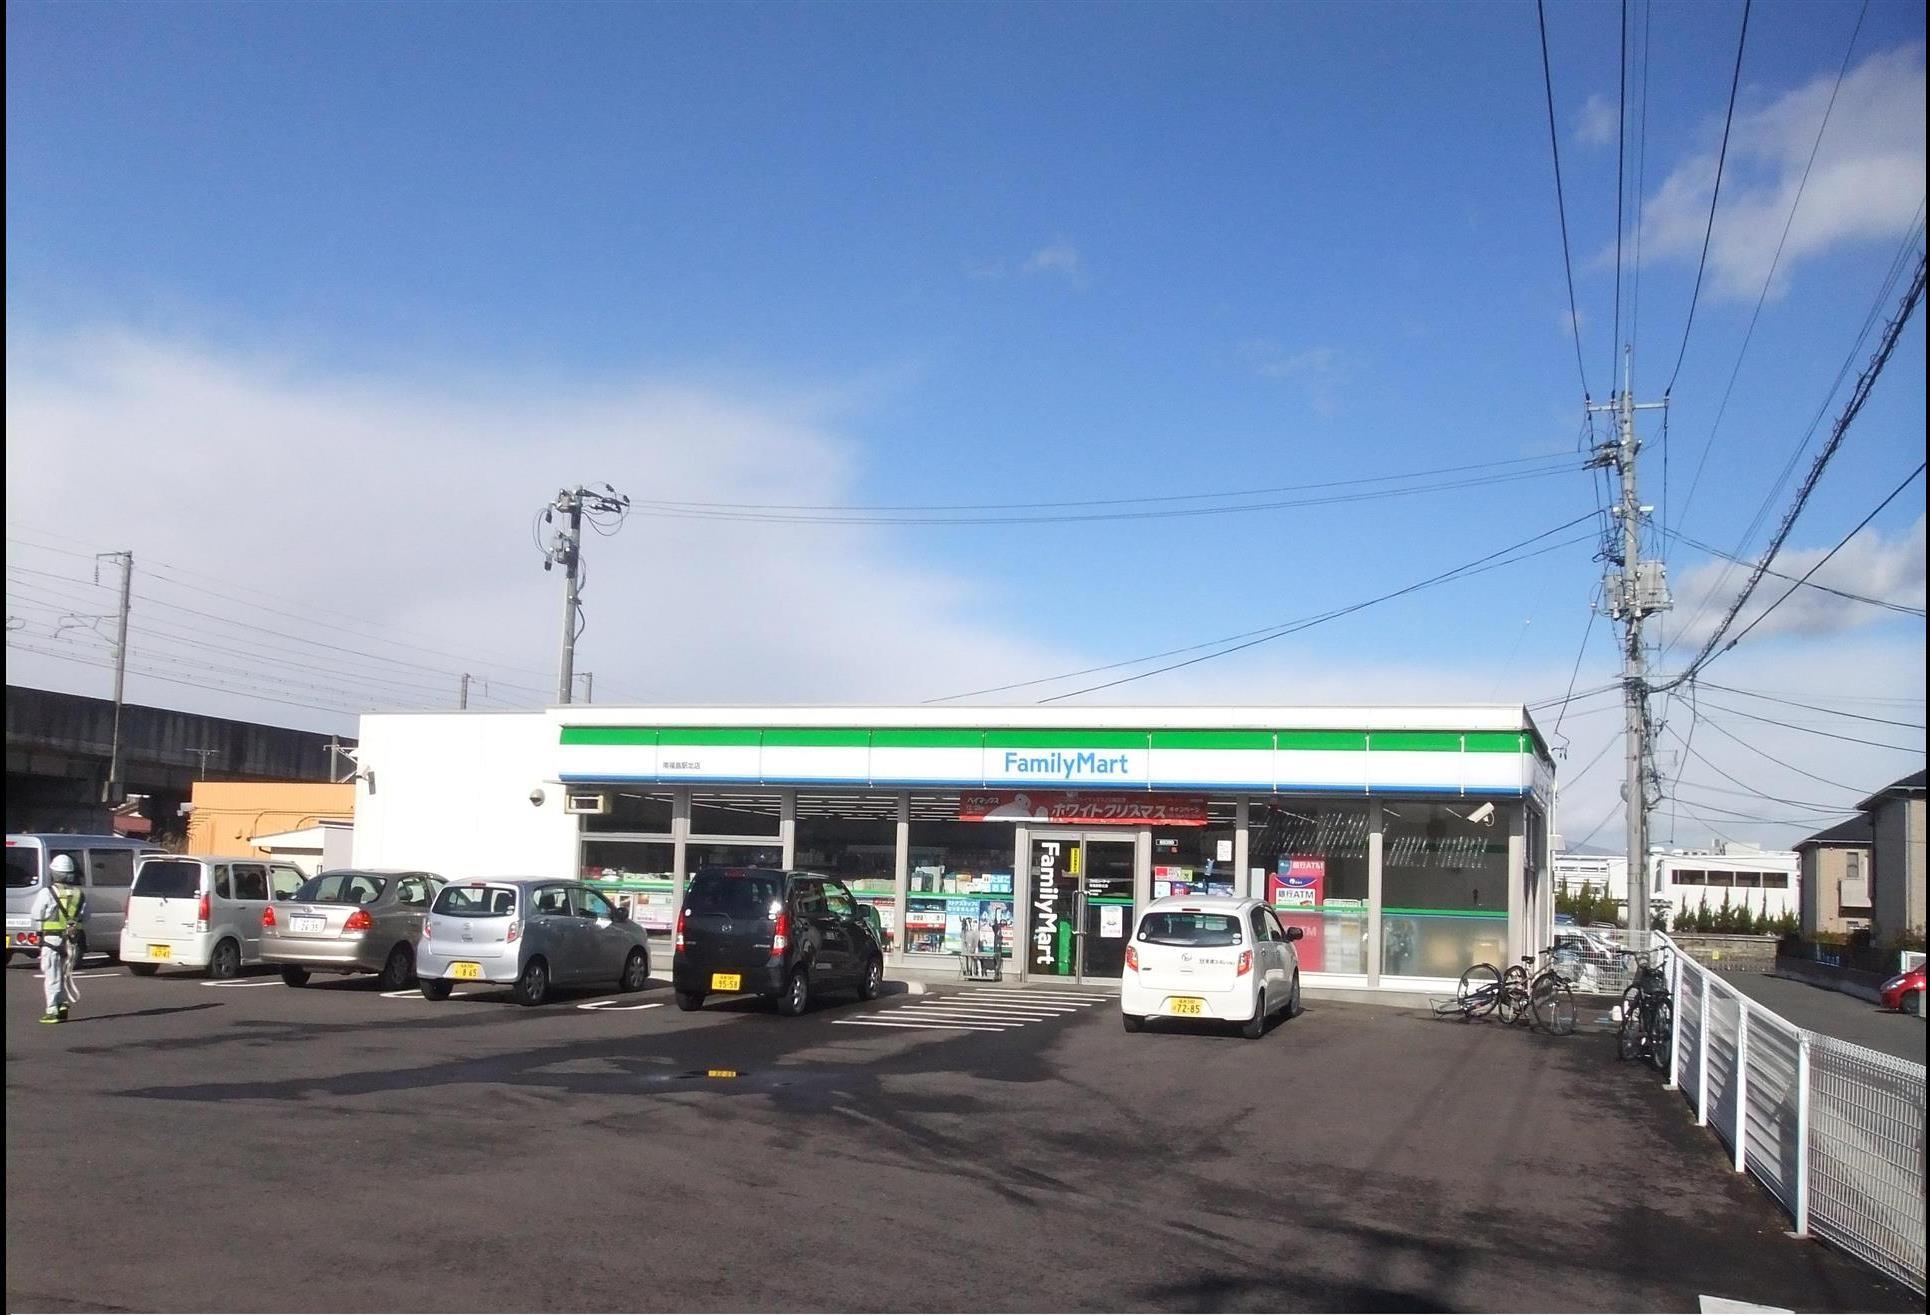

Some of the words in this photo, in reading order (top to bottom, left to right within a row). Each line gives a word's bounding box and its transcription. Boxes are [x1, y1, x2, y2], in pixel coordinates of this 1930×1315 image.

[1005, 752, 1128, 779] FamilyMart
[1051, 803, 1167, 819] ホワイトクリスマス
[1034, 842, 1060, 965] FamilyMart
[1176, 1004, 1201, 1014] 72-85
